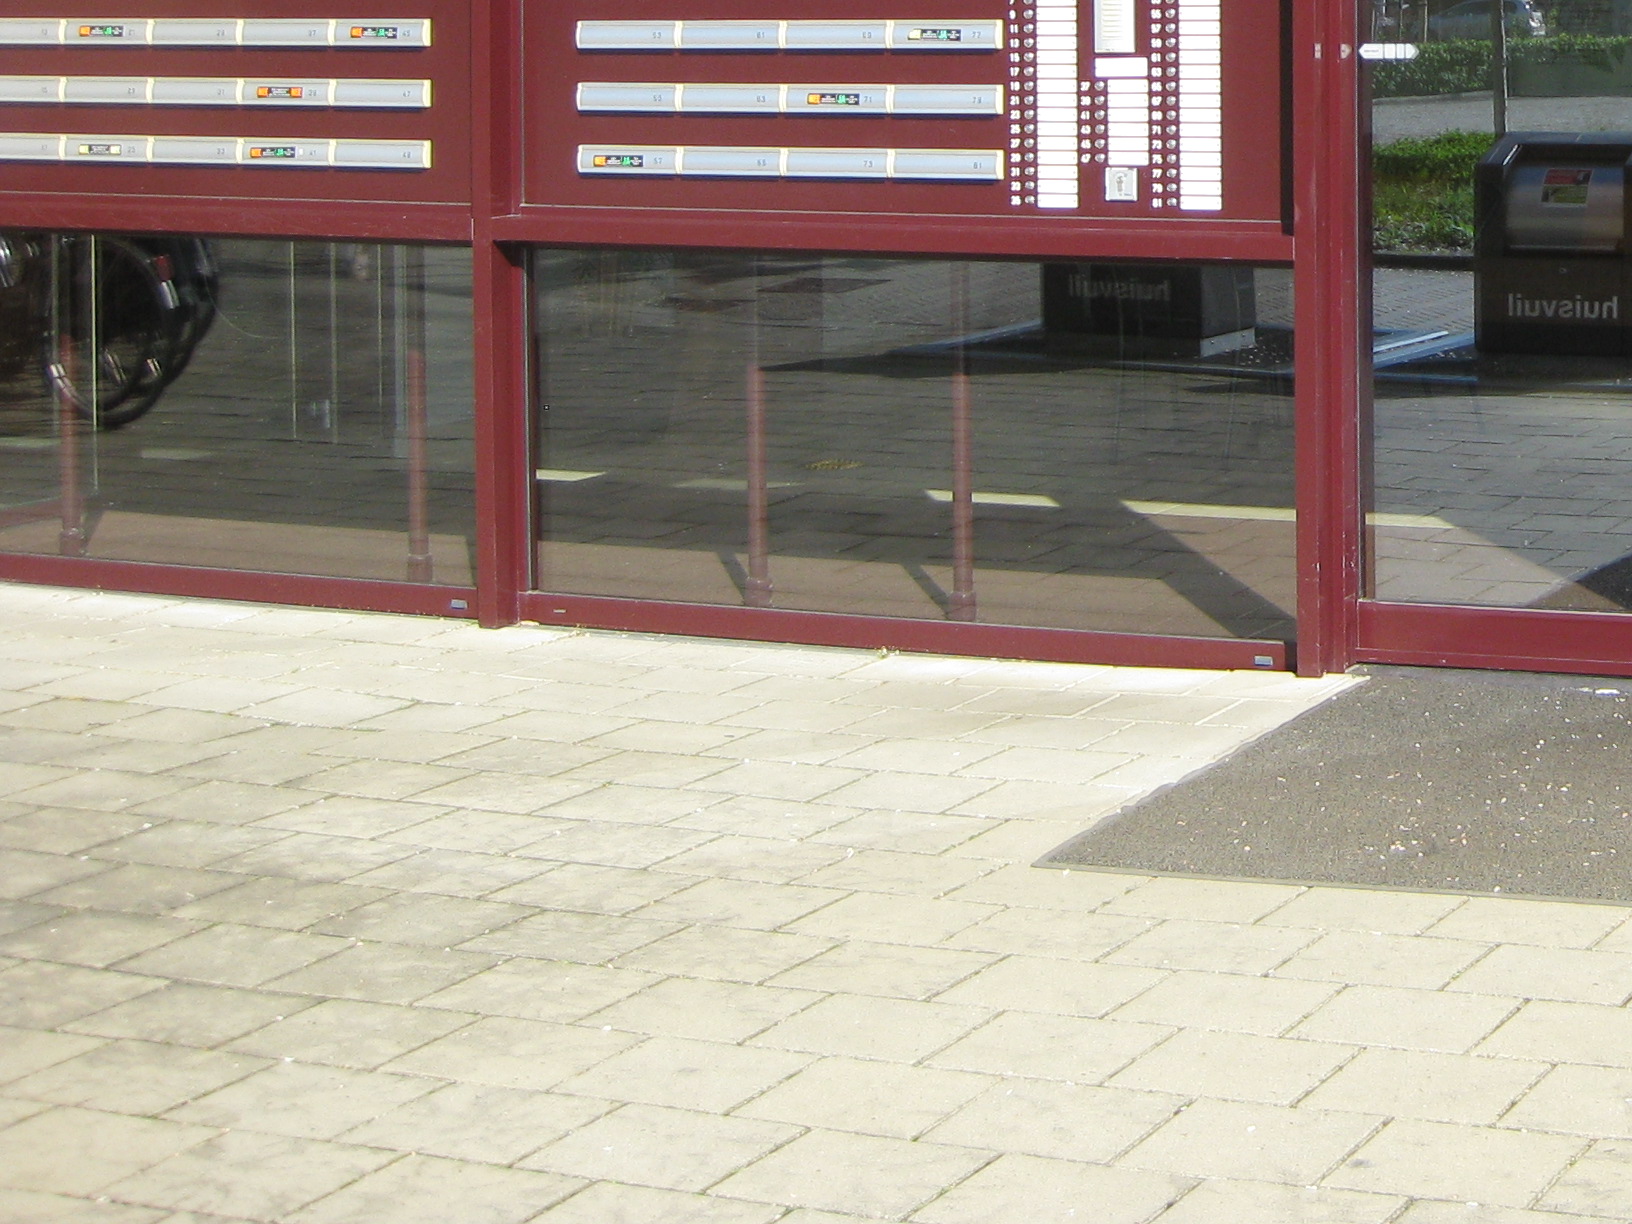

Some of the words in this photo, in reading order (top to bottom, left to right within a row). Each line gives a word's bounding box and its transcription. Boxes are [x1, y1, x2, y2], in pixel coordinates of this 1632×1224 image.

[1009, 24, 1019, 34] 11
[1009, 66, 1020, 77] 17
[1009, 95, 1020, 106] 21
[1080, 110, 1090, 120] 41
[1151, 124, 1162, 136] 71
[1151, 138, 1163, 150] 73
[1151, 153, 1163, 165] 75
[1010, 166, 1021, 177] 31
[1151, 168, 1163, 179] 77
